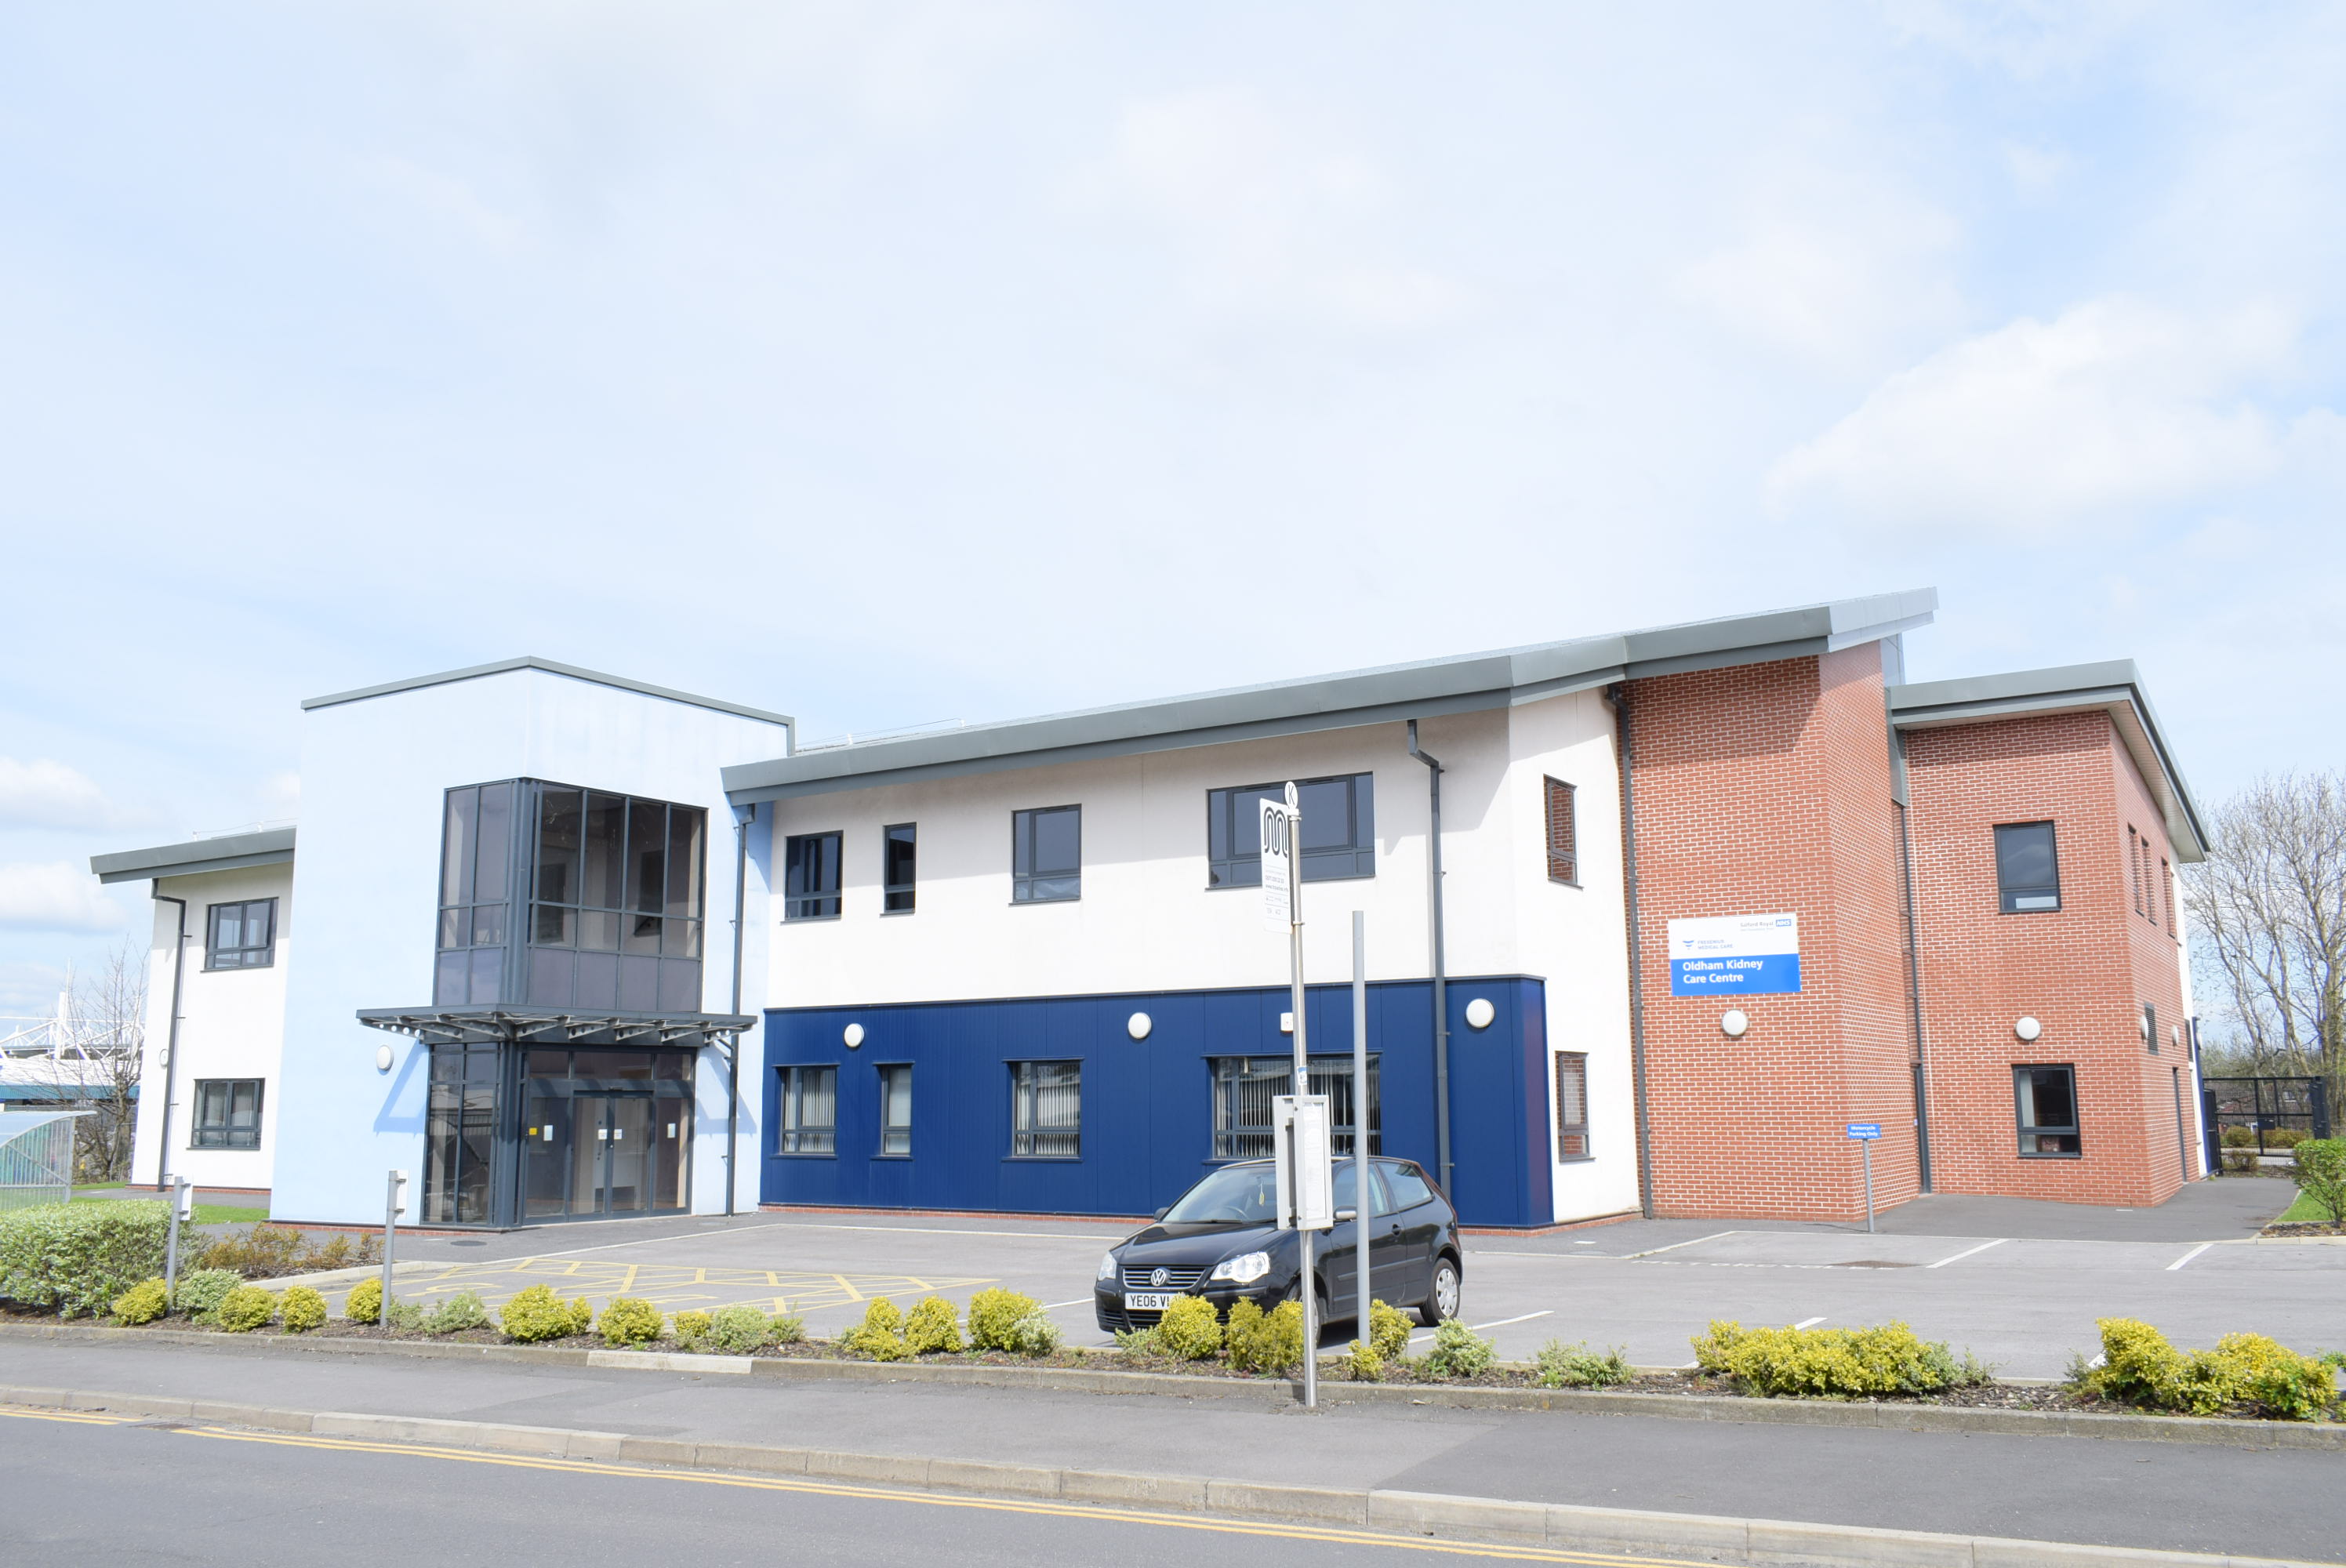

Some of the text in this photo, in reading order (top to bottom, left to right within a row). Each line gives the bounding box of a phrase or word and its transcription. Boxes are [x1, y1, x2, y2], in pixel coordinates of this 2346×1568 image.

[1287, 784, 1295, 805] K
[1683, 959, 1763, 971] Oldham Kidney
[1683, 973, 1744, 984] Care Centre
[1130, 1295, 1157, 1307] YE06
